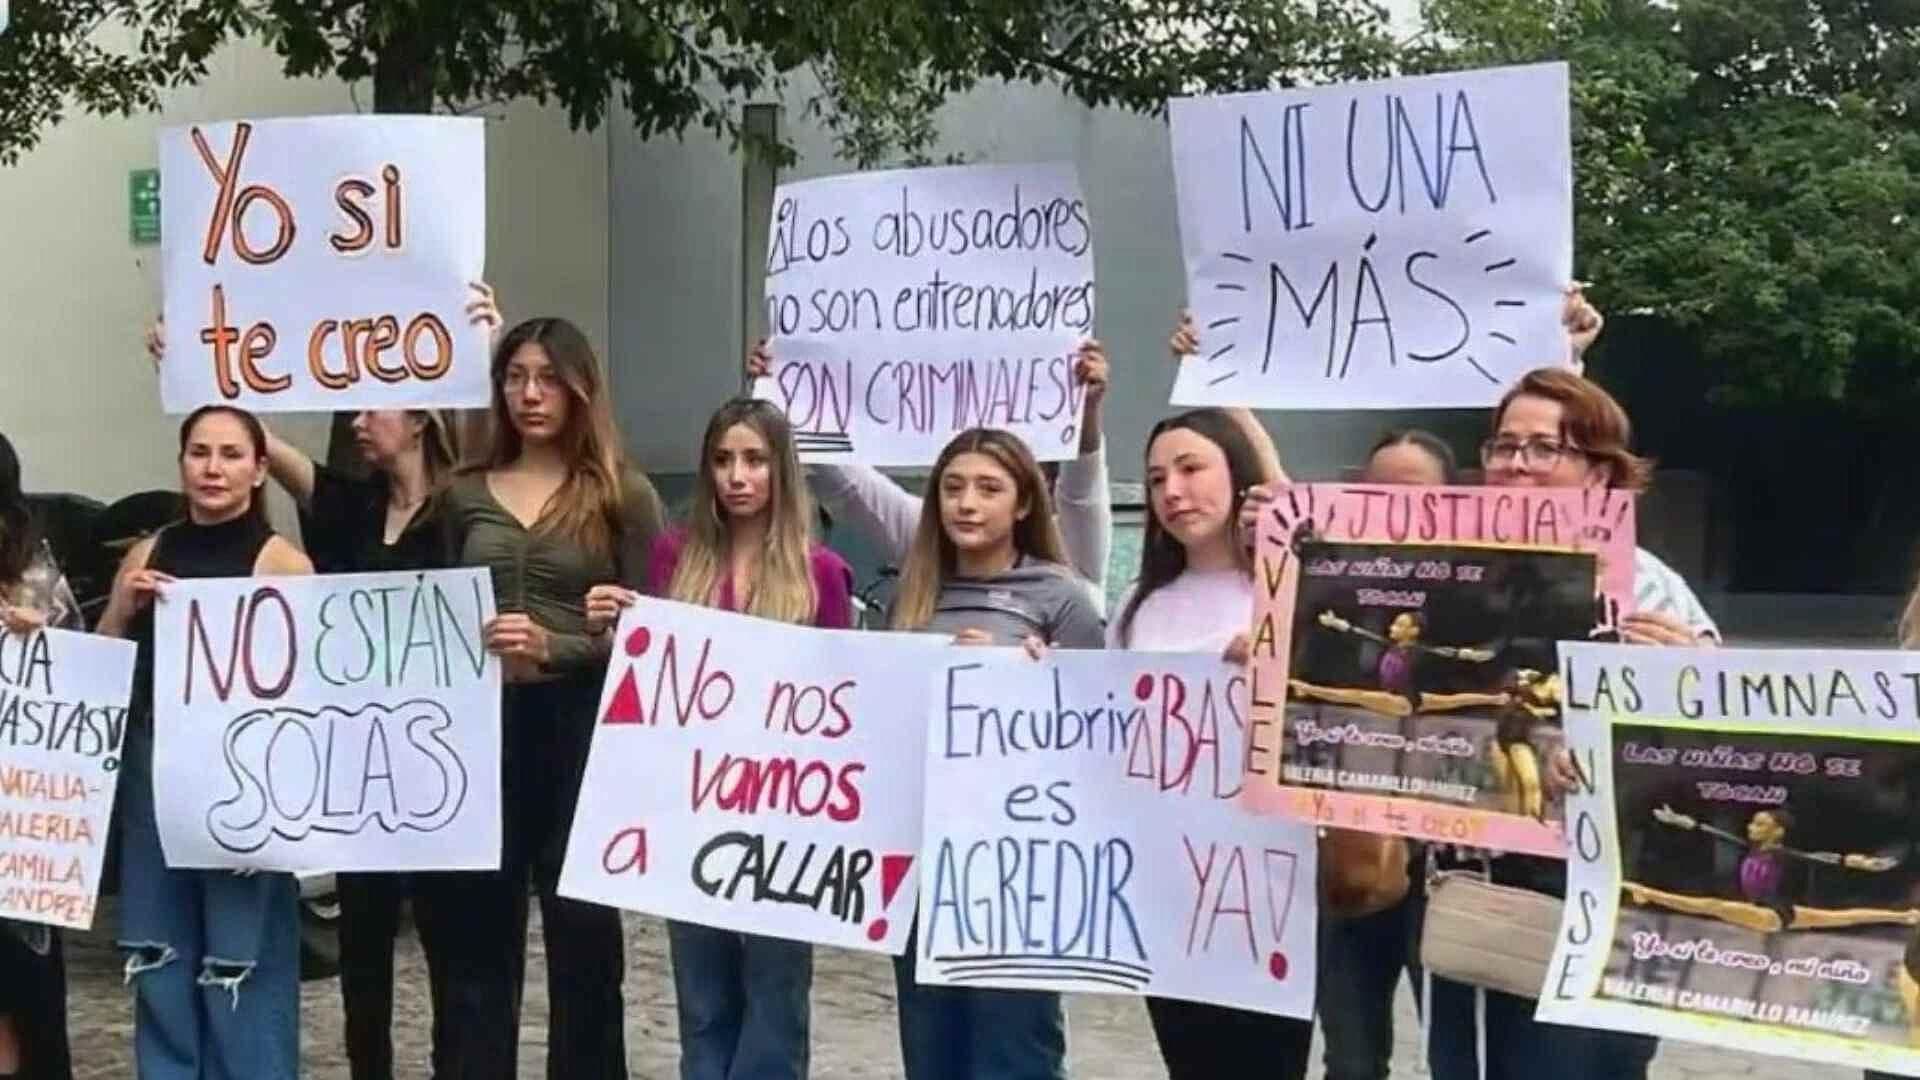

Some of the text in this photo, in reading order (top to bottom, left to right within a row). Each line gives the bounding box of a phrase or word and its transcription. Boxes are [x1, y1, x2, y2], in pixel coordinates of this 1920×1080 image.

[192, 122, 402, 264] Yo si
[1242, 90, 1496, 232] NI UNA
[768, 184, 1091, 276] ¡Los abusadores
[202, 284, 453, 399] te creo
[769, 294, 800, 335] no
[809, 287, 882, 333] son
[1262, 232, 1471, 378] MÁS
[778, 354, 1083, 444] SON CRIMINALES!
[1341, 490, 1559, 543] JUSTICIA
[185, 573, 487, 705] NO ESTÁN
[601, 626, 857, 738] ¡No nos
[1565, 656, 1643, 714] LAS
[945, 664, 1139, 758] Encubrir
[213, 707, 458, 841] SOLAS
[691, 749, 866, 822] vamos
[1005, 781, 1076, 826] es
[602, 827, 914, 942] a CALLAR!
[926, 834, 1297, 981] AGREDIR YA!
